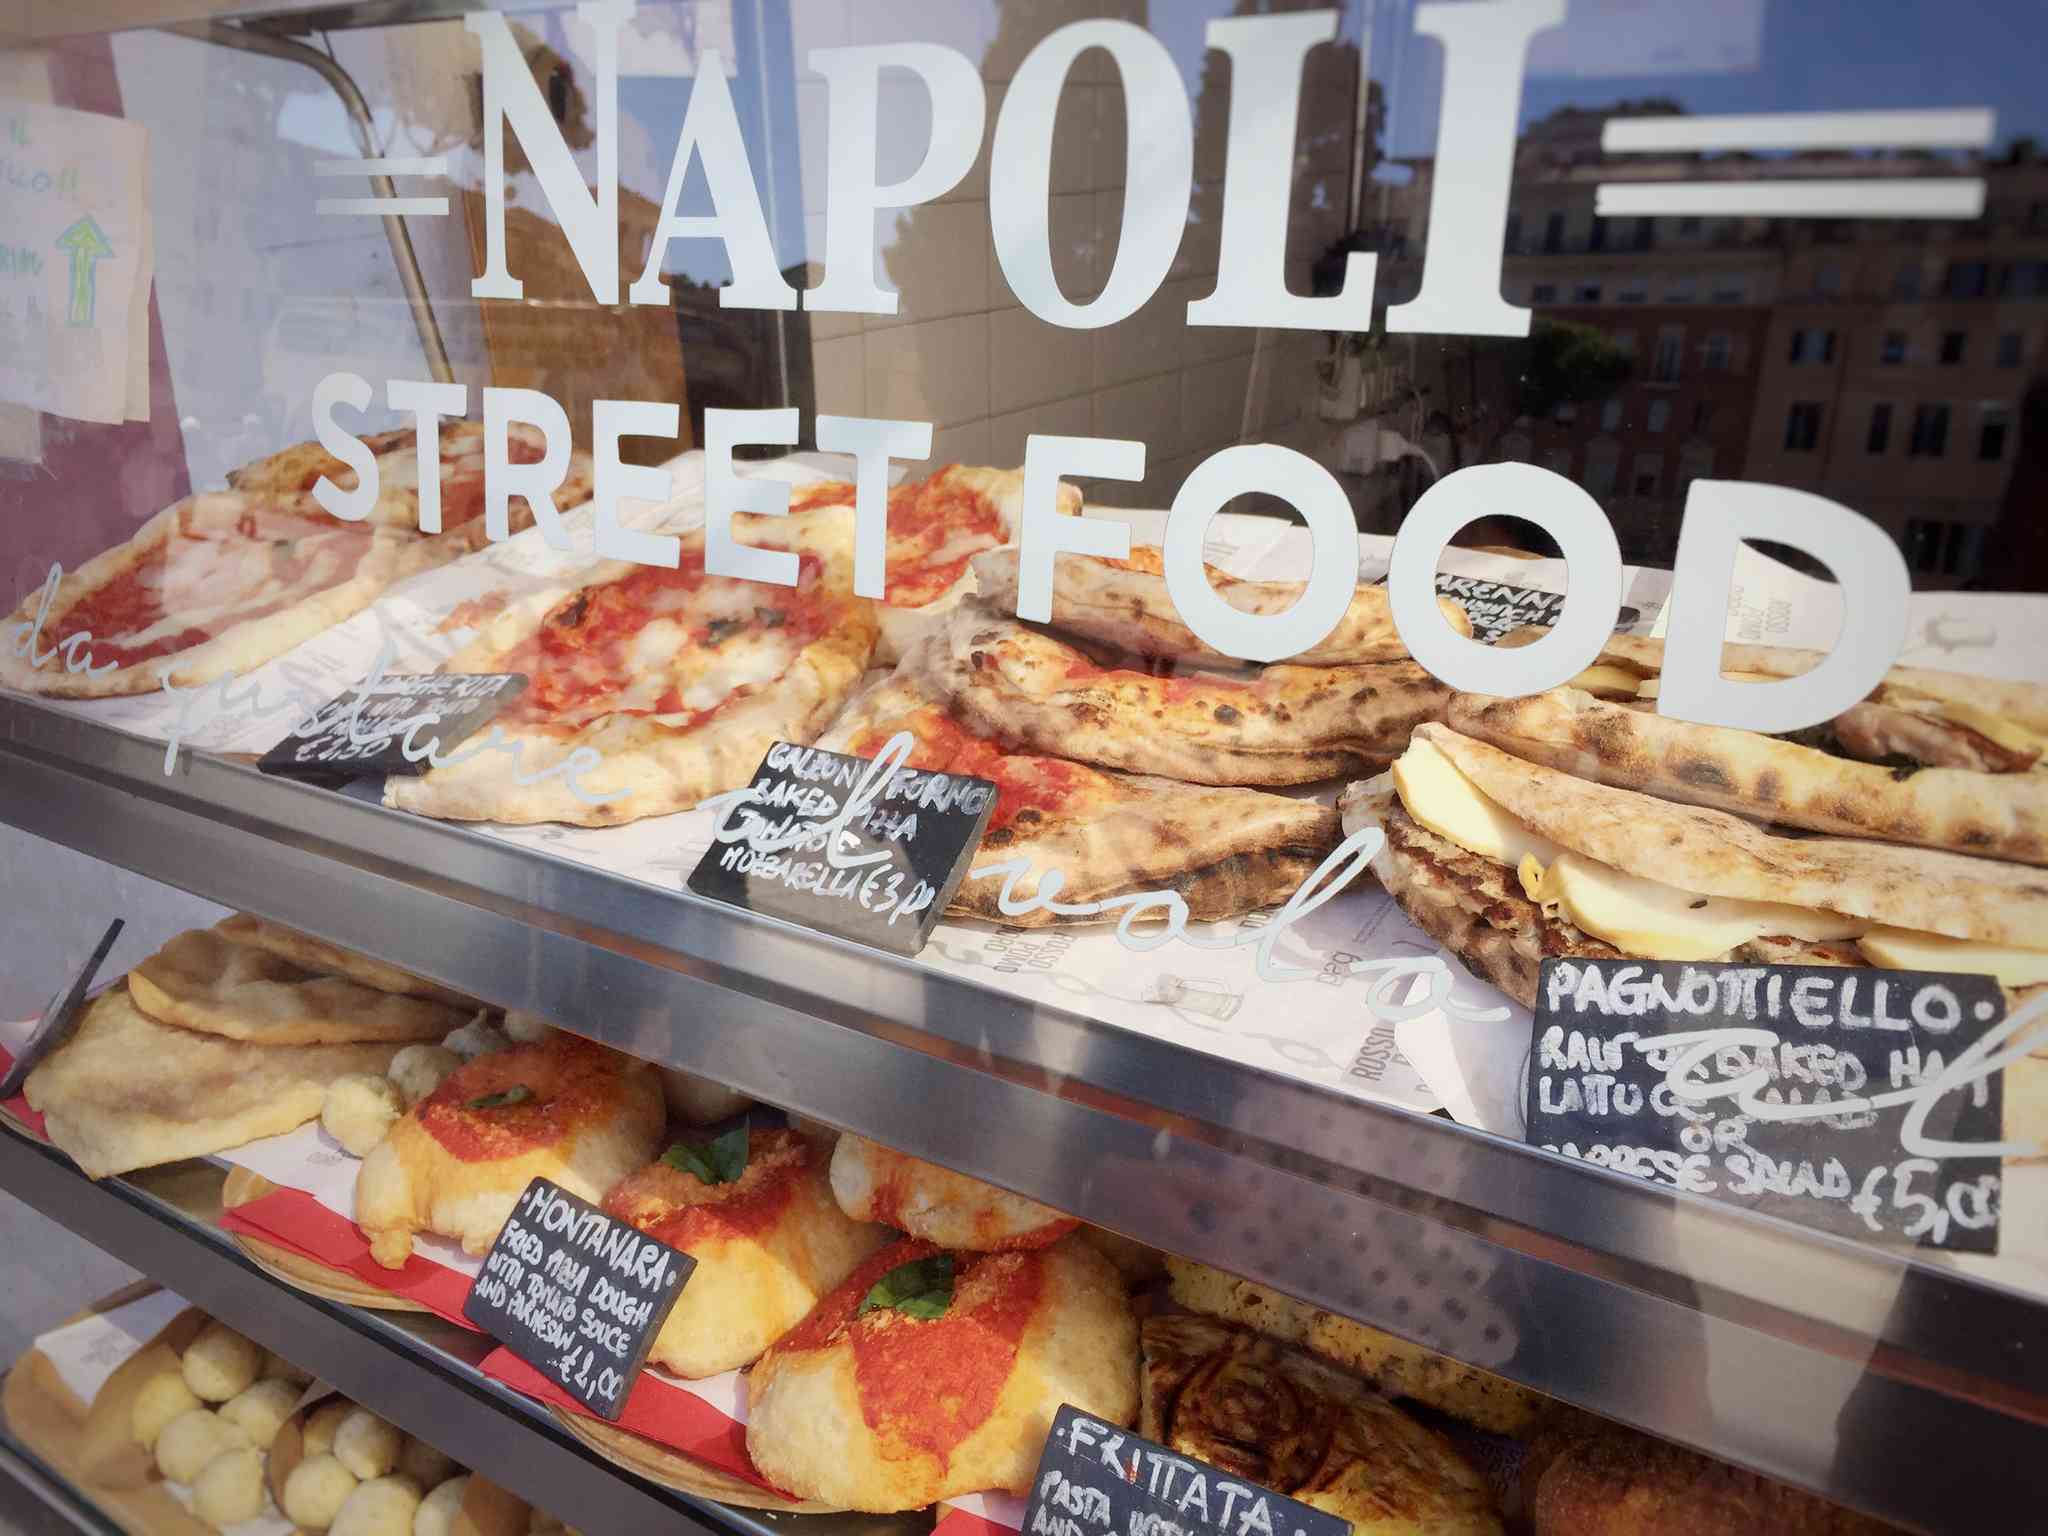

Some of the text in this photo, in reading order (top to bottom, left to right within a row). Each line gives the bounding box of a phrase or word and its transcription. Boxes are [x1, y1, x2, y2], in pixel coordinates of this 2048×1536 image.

[464, 0, 1568, 338] NAPOLI
[310, 371, 1912, 733] STREET FOOD
[9, 560, 118, 676] da
[160, 632, 632, 804] gustare
[696, 730, 914, 869] al
[475, 1275, 506, 1308] AND
[527, 1272, 577, 1322] TOMATO
[588, 1276, 653, 1326] DOUGH
[1039, 1469, 1112, 1528] PASTA
